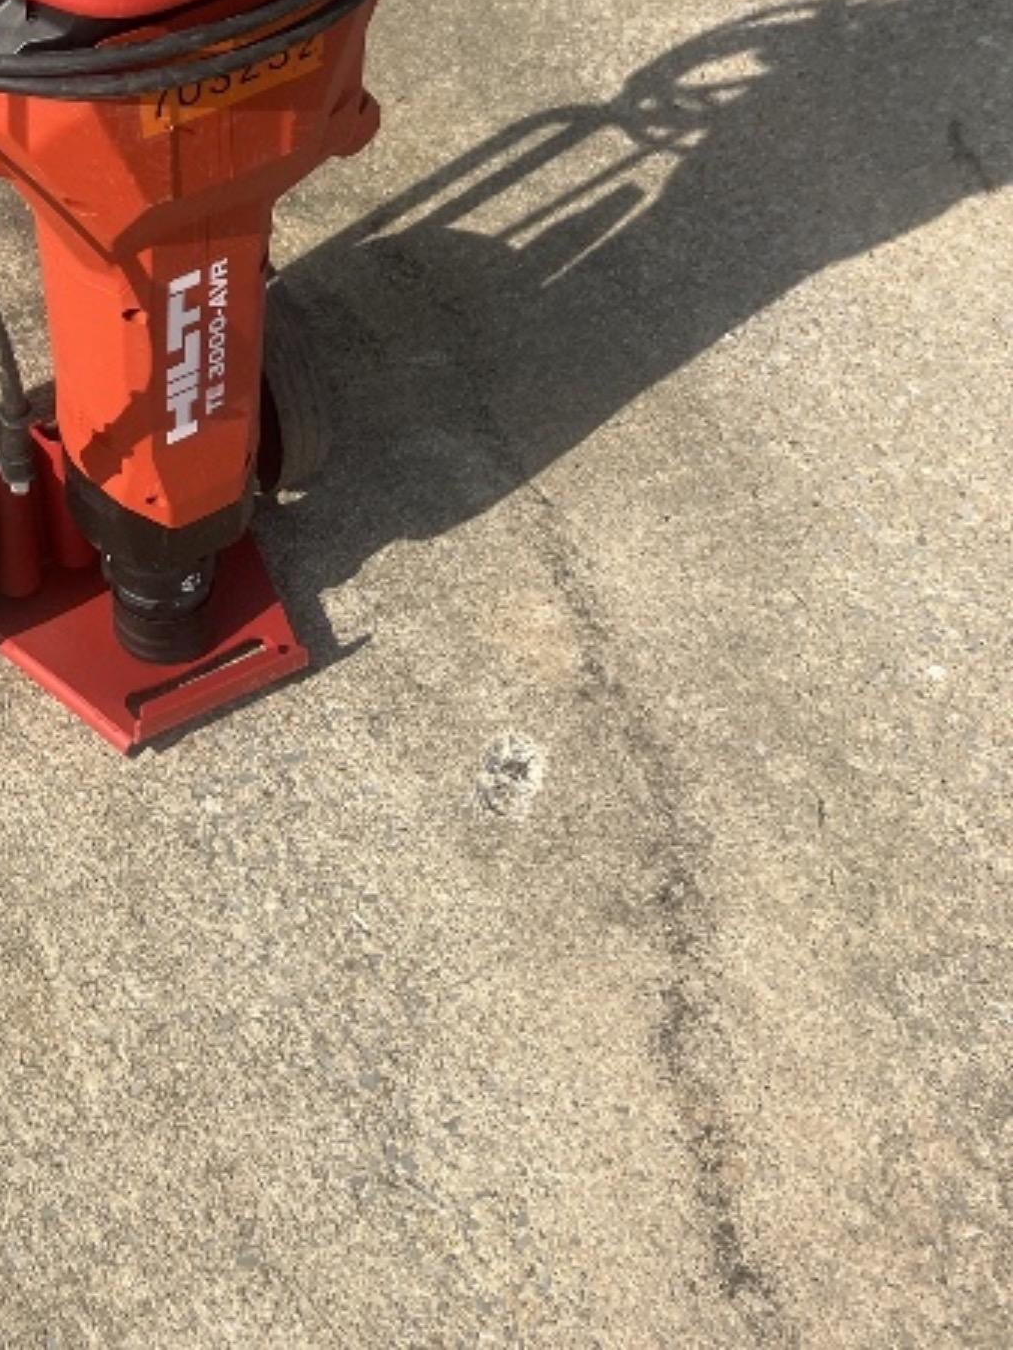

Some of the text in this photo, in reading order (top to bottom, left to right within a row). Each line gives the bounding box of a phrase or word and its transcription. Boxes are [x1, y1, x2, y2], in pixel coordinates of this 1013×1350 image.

[167, 269, 201, 445] HILTI
[206, 257, 228, 415] TE 3000-AVR
